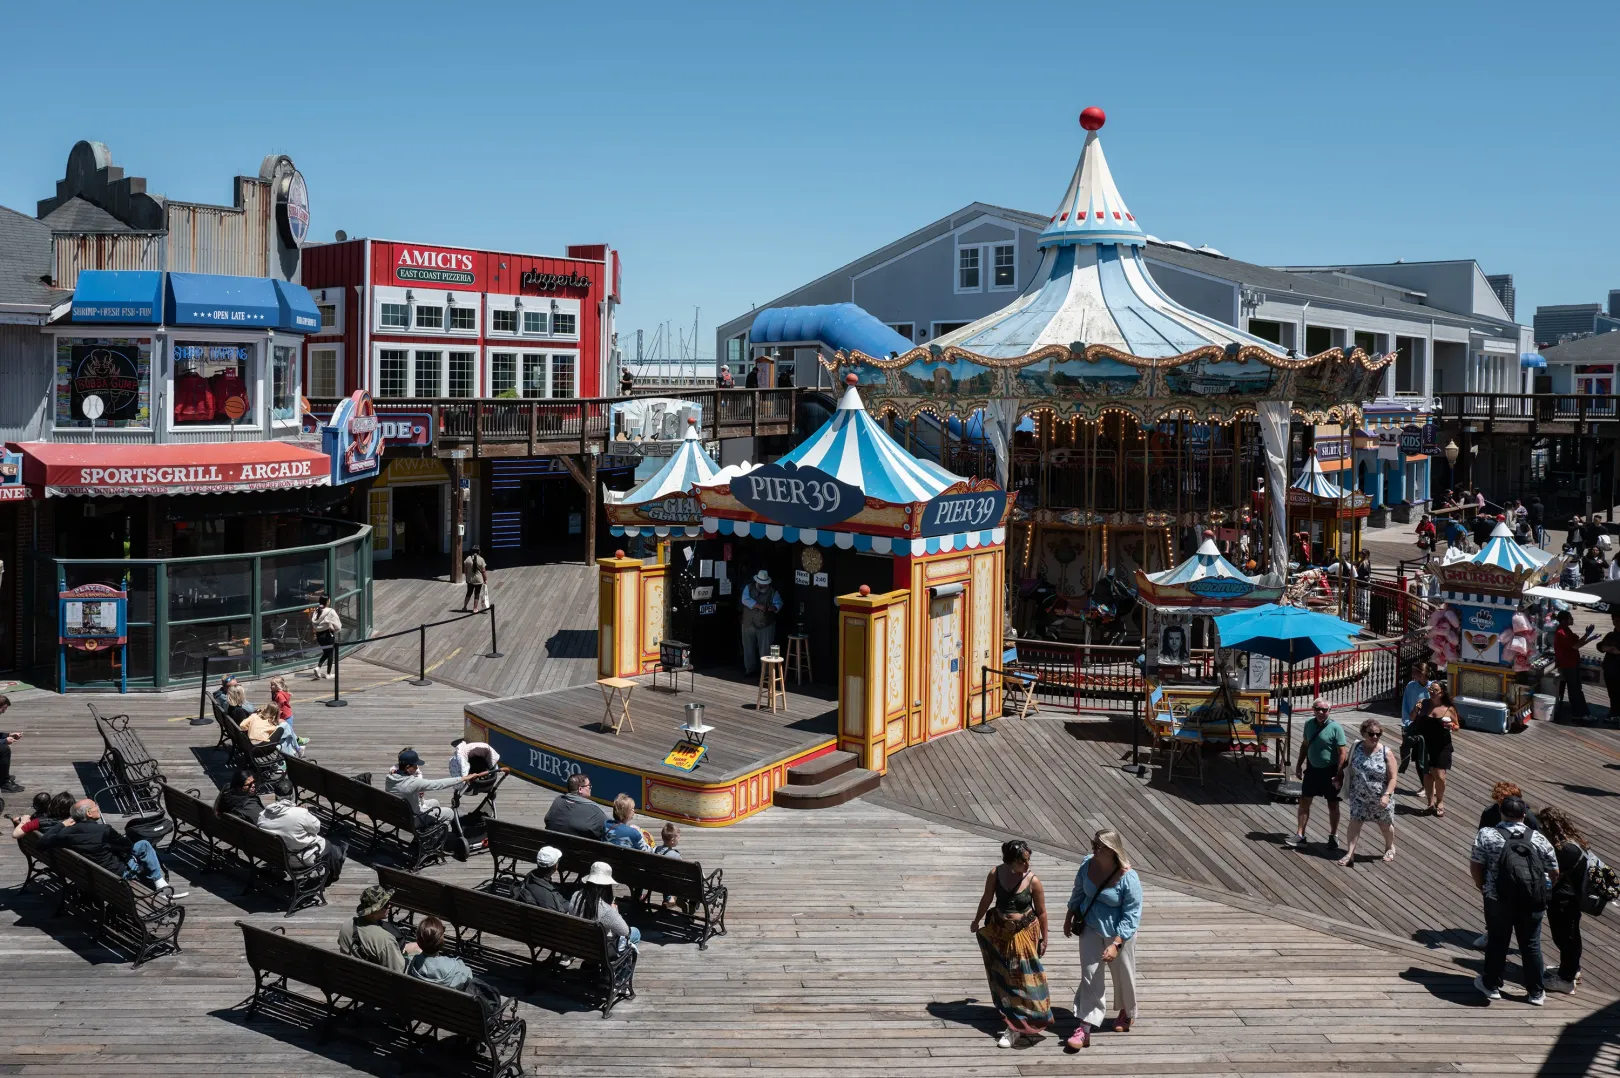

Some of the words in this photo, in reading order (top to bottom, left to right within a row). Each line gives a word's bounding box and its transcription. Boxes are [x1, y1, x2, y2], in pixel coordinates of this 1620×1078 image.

[398, 250, 472, 270] AMICI'S
[400, 270, 418, 278] EAST
[419, 271, 441, 280] COAST
[442, 273, 472, 283] PIZZERIA
[522, 268, 592, 291] pizzeria
[73, 307, 97, 316] SHRIMP
[100, 308, 120, 316] FRESH
[122, 308, 136, 316] FISH
[139, 308, 151, 317] FUN
[213, 310, 228, 320] OPEN
[231, 311, 245, 320] LATE
[1402, 436, 1420, 447] KIDS
[80, 466, 222, 484] SPORTSGRILL
[240, 461, 311, 480] ARCADE
[0, 488, 33, 499] NER
[184, 484, 203, 492] LIVE
[664, 498, 701, 513] GIA
[1444, 569, 1515, 585] CHURROS
[74, 586, 111, 594] PLAYERS
[700, 604, 716, 613] OPEN
